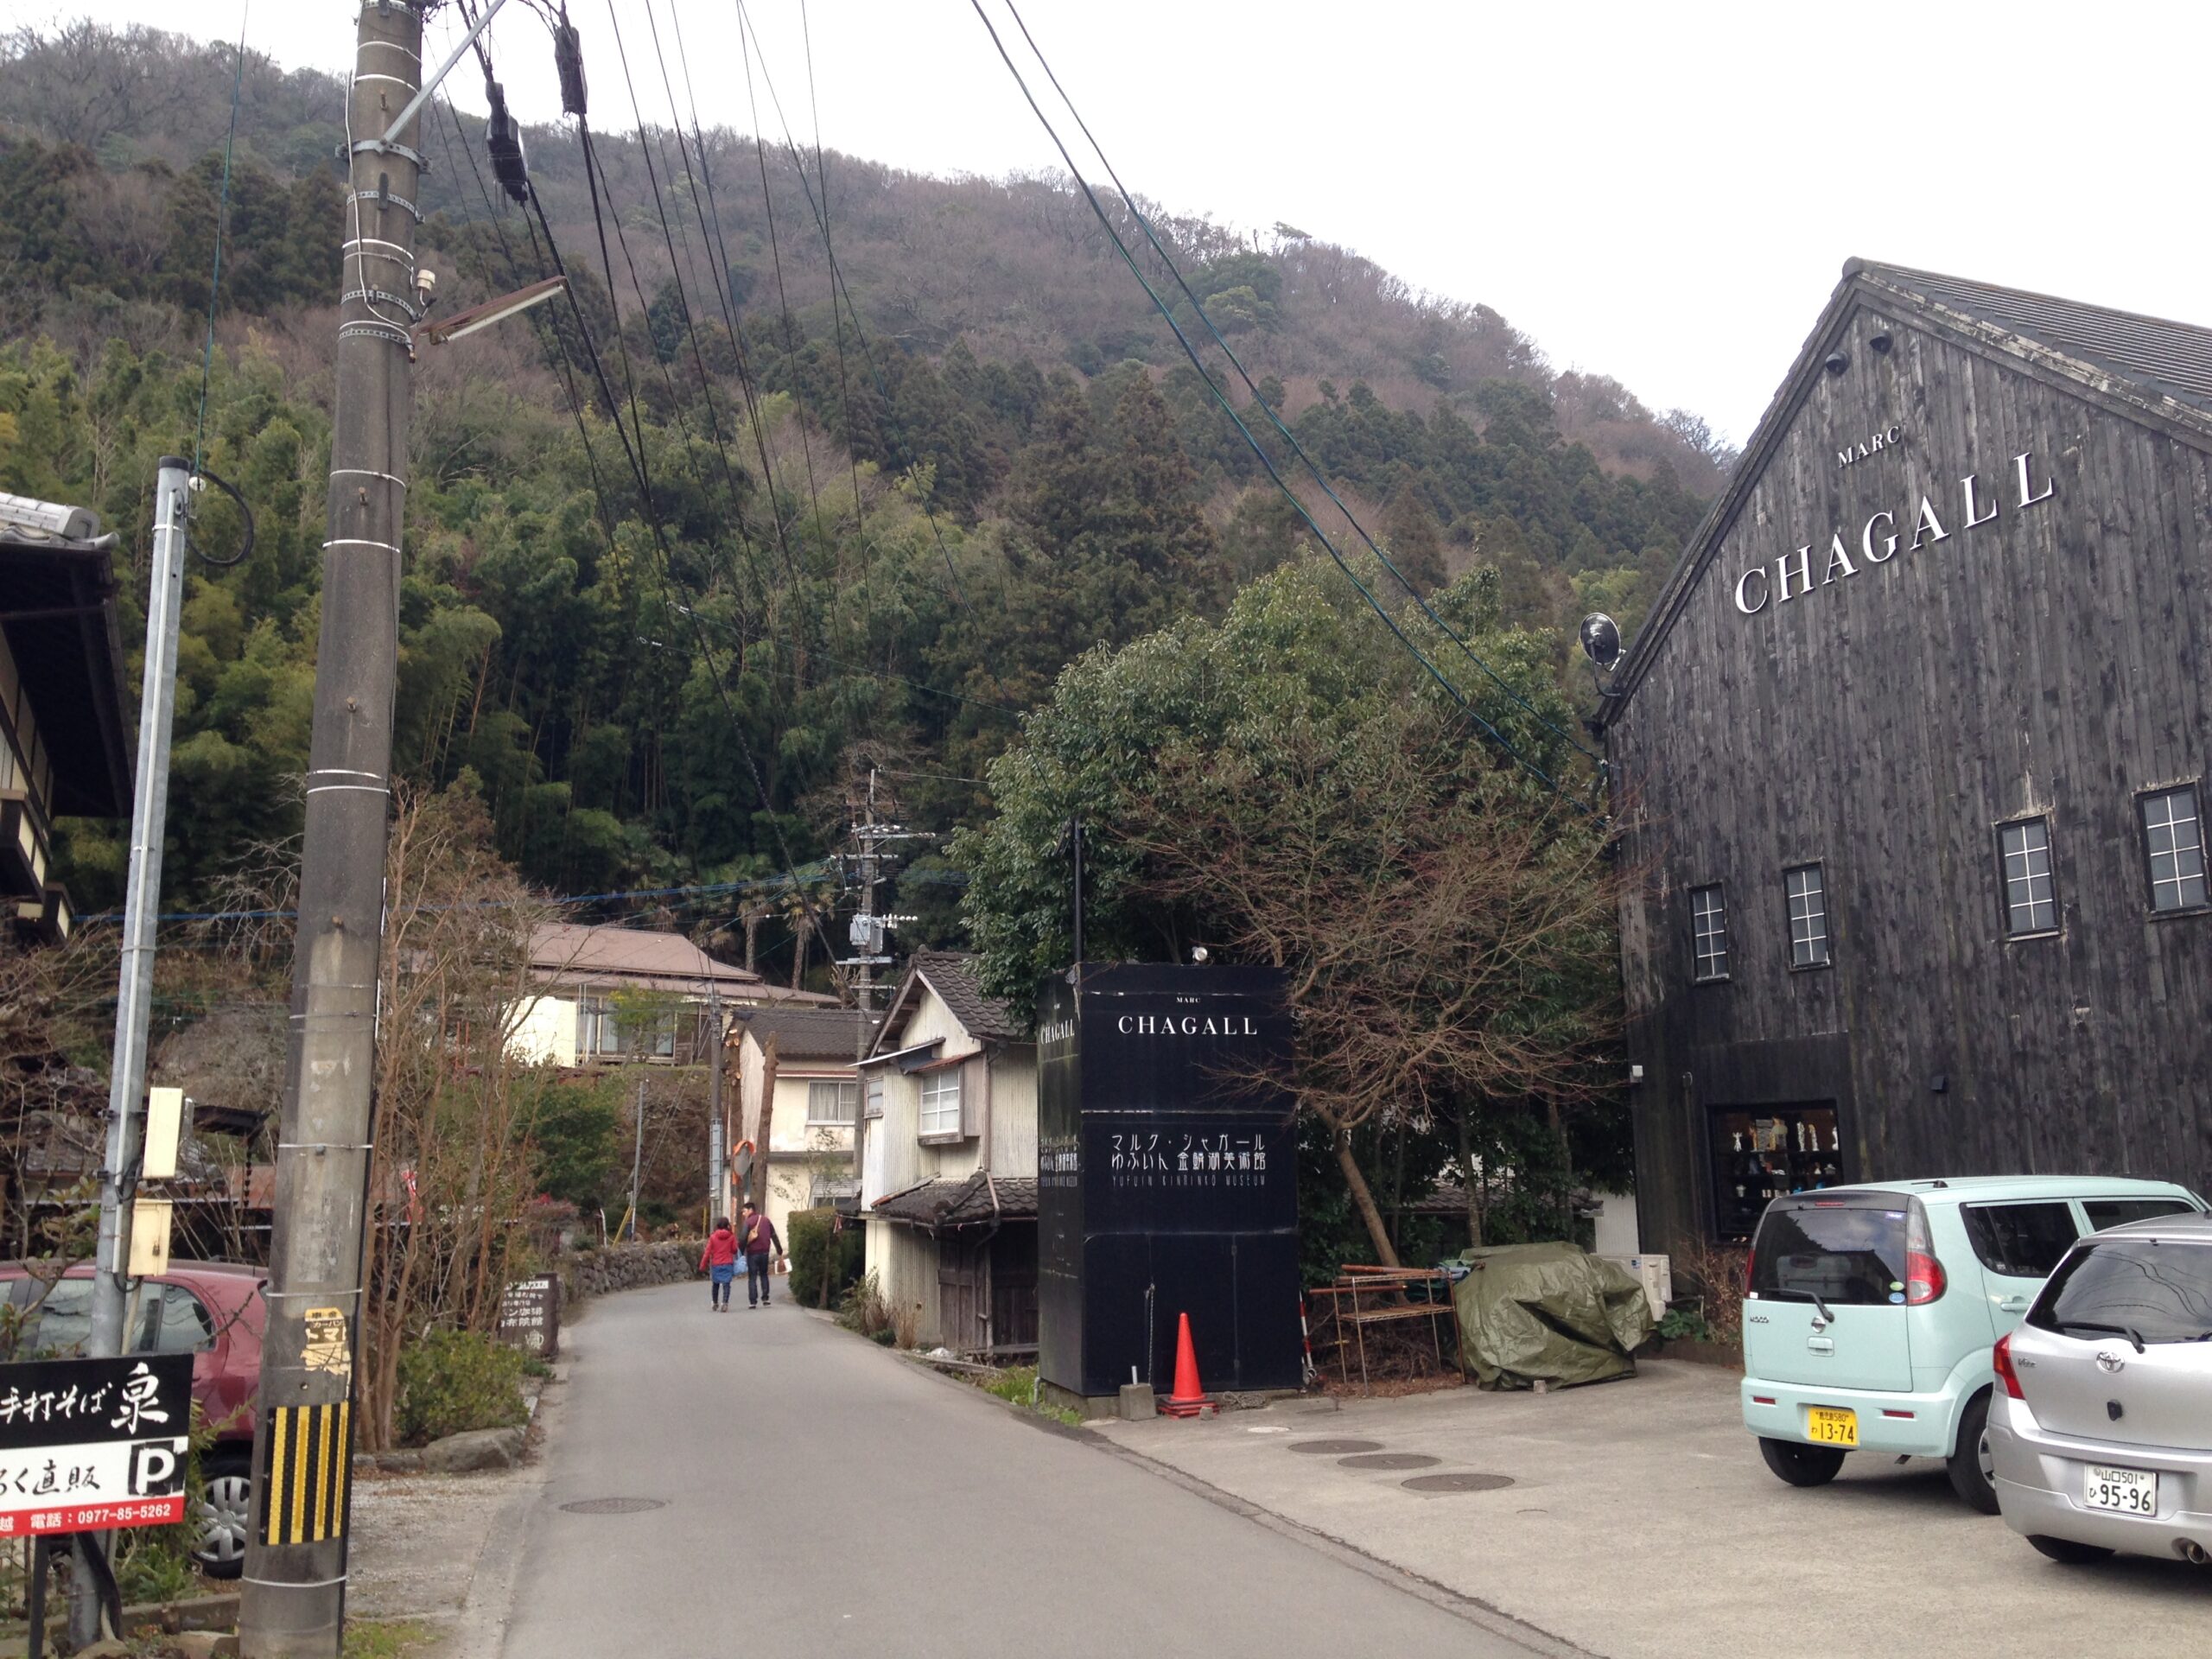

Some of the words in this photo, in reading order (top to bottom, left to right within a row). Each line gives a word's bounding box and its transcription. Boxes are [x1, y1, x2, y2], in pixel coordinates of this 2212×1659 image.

[1837, 426, 1900, 468] MARC
[1734, 452, 2054, 614] CHAGALL
[1040, 1019, 1075, 1045] CHAGALL
[1118, 1015, 1257, 1035] CHAGALL
[1112, 1134, 1265, 1151] マルク・シャガール
[1112, 1152, 1168, 1170] ゆふいん
[1112, 1174, 1152, 1187] YUFUIN
[1225, 1174, 1266, 1187] MUSEUM
[0, 1381, 113, 1424] 手打そば
[111, 1362, 169, 1434] 泉
[1821, 1422, 1854, 1442] 13-74
[136, 1448, 175, 1495] P
[2101, 1470, 2138, 1485] 山口501
[2089, 1487, 2097, 1498] ひ
[2100, 1484, 2151, 1511] 95-96
